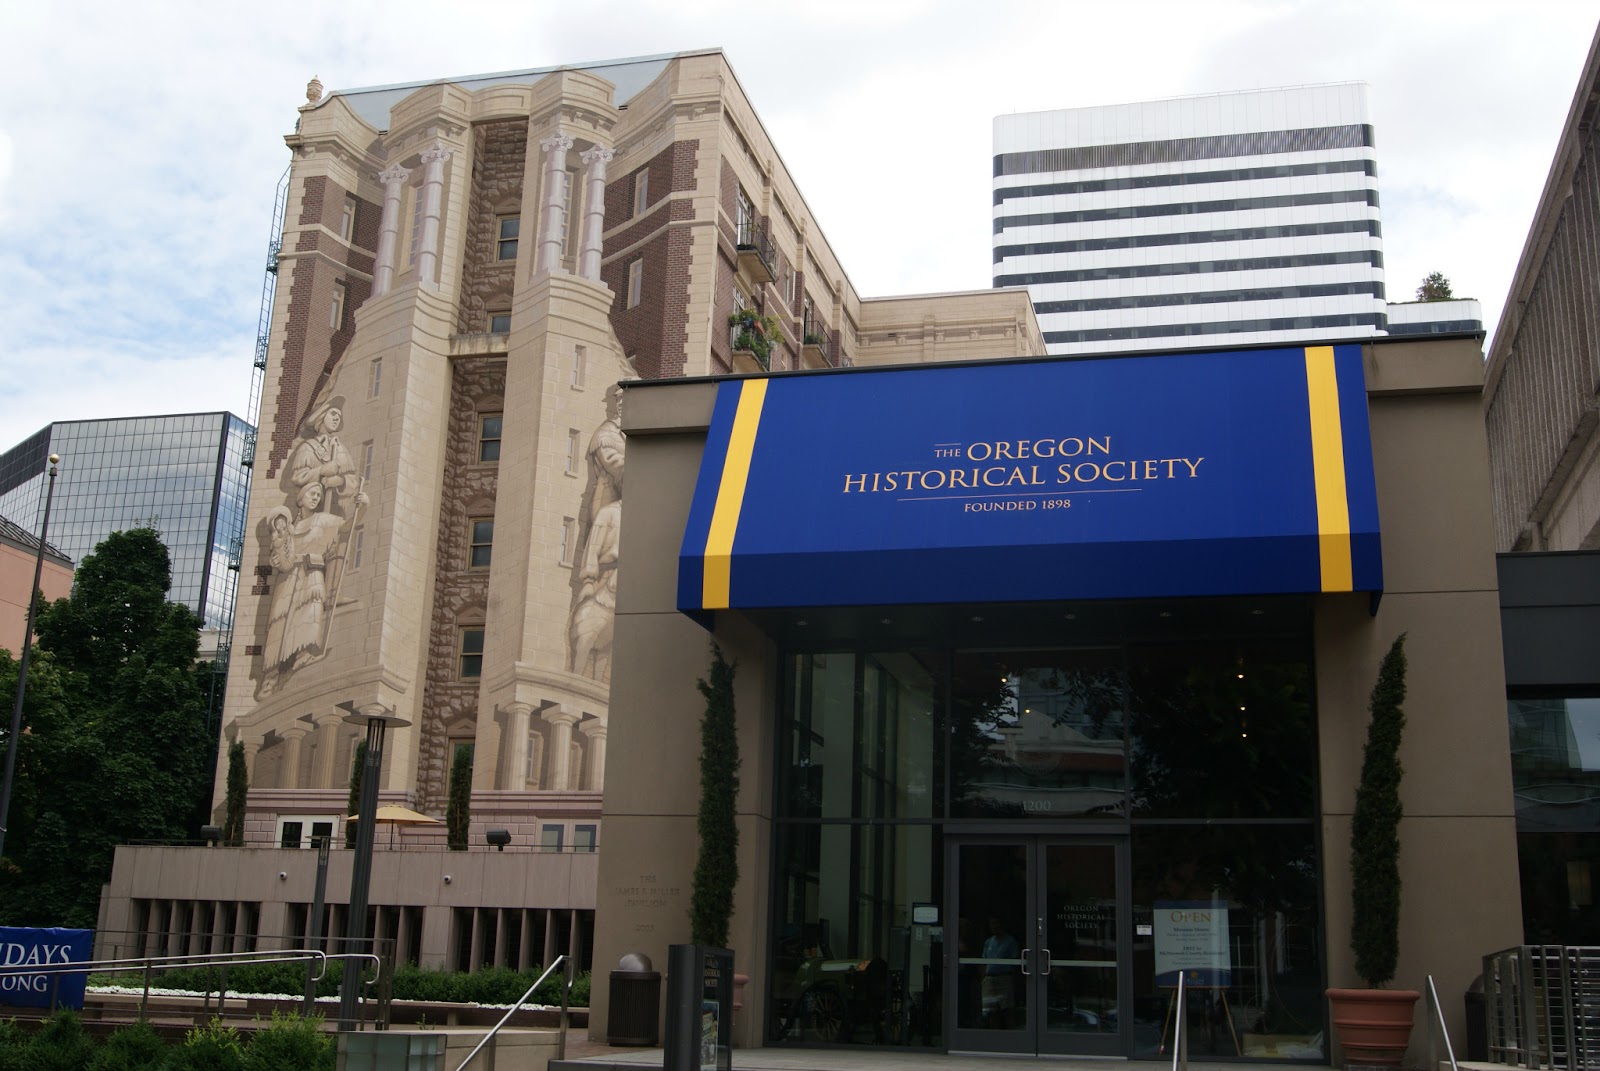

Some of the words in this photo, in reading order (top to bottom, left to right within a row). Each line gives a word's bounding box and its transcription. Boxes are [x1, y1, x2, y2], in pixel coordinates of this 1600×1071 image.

[934, 448, 961, 458] THE
[966, 435, 1111, 461] OREGON
[842, 464, 1046, 493] HISTORICAL
[1056, 456, 1205, 484] SOCIETY
[964, 500, 1036, 513] FOUNDED
[1041, 499, 1071, 510] 1898
[1022, 800, 1051, 811] 1200
[1063, 904, 1098, 912] OREGON
[1056, 912, 1105, 921] HISTORICAL
[1064, 921, 1098, 929] SOCIETY
